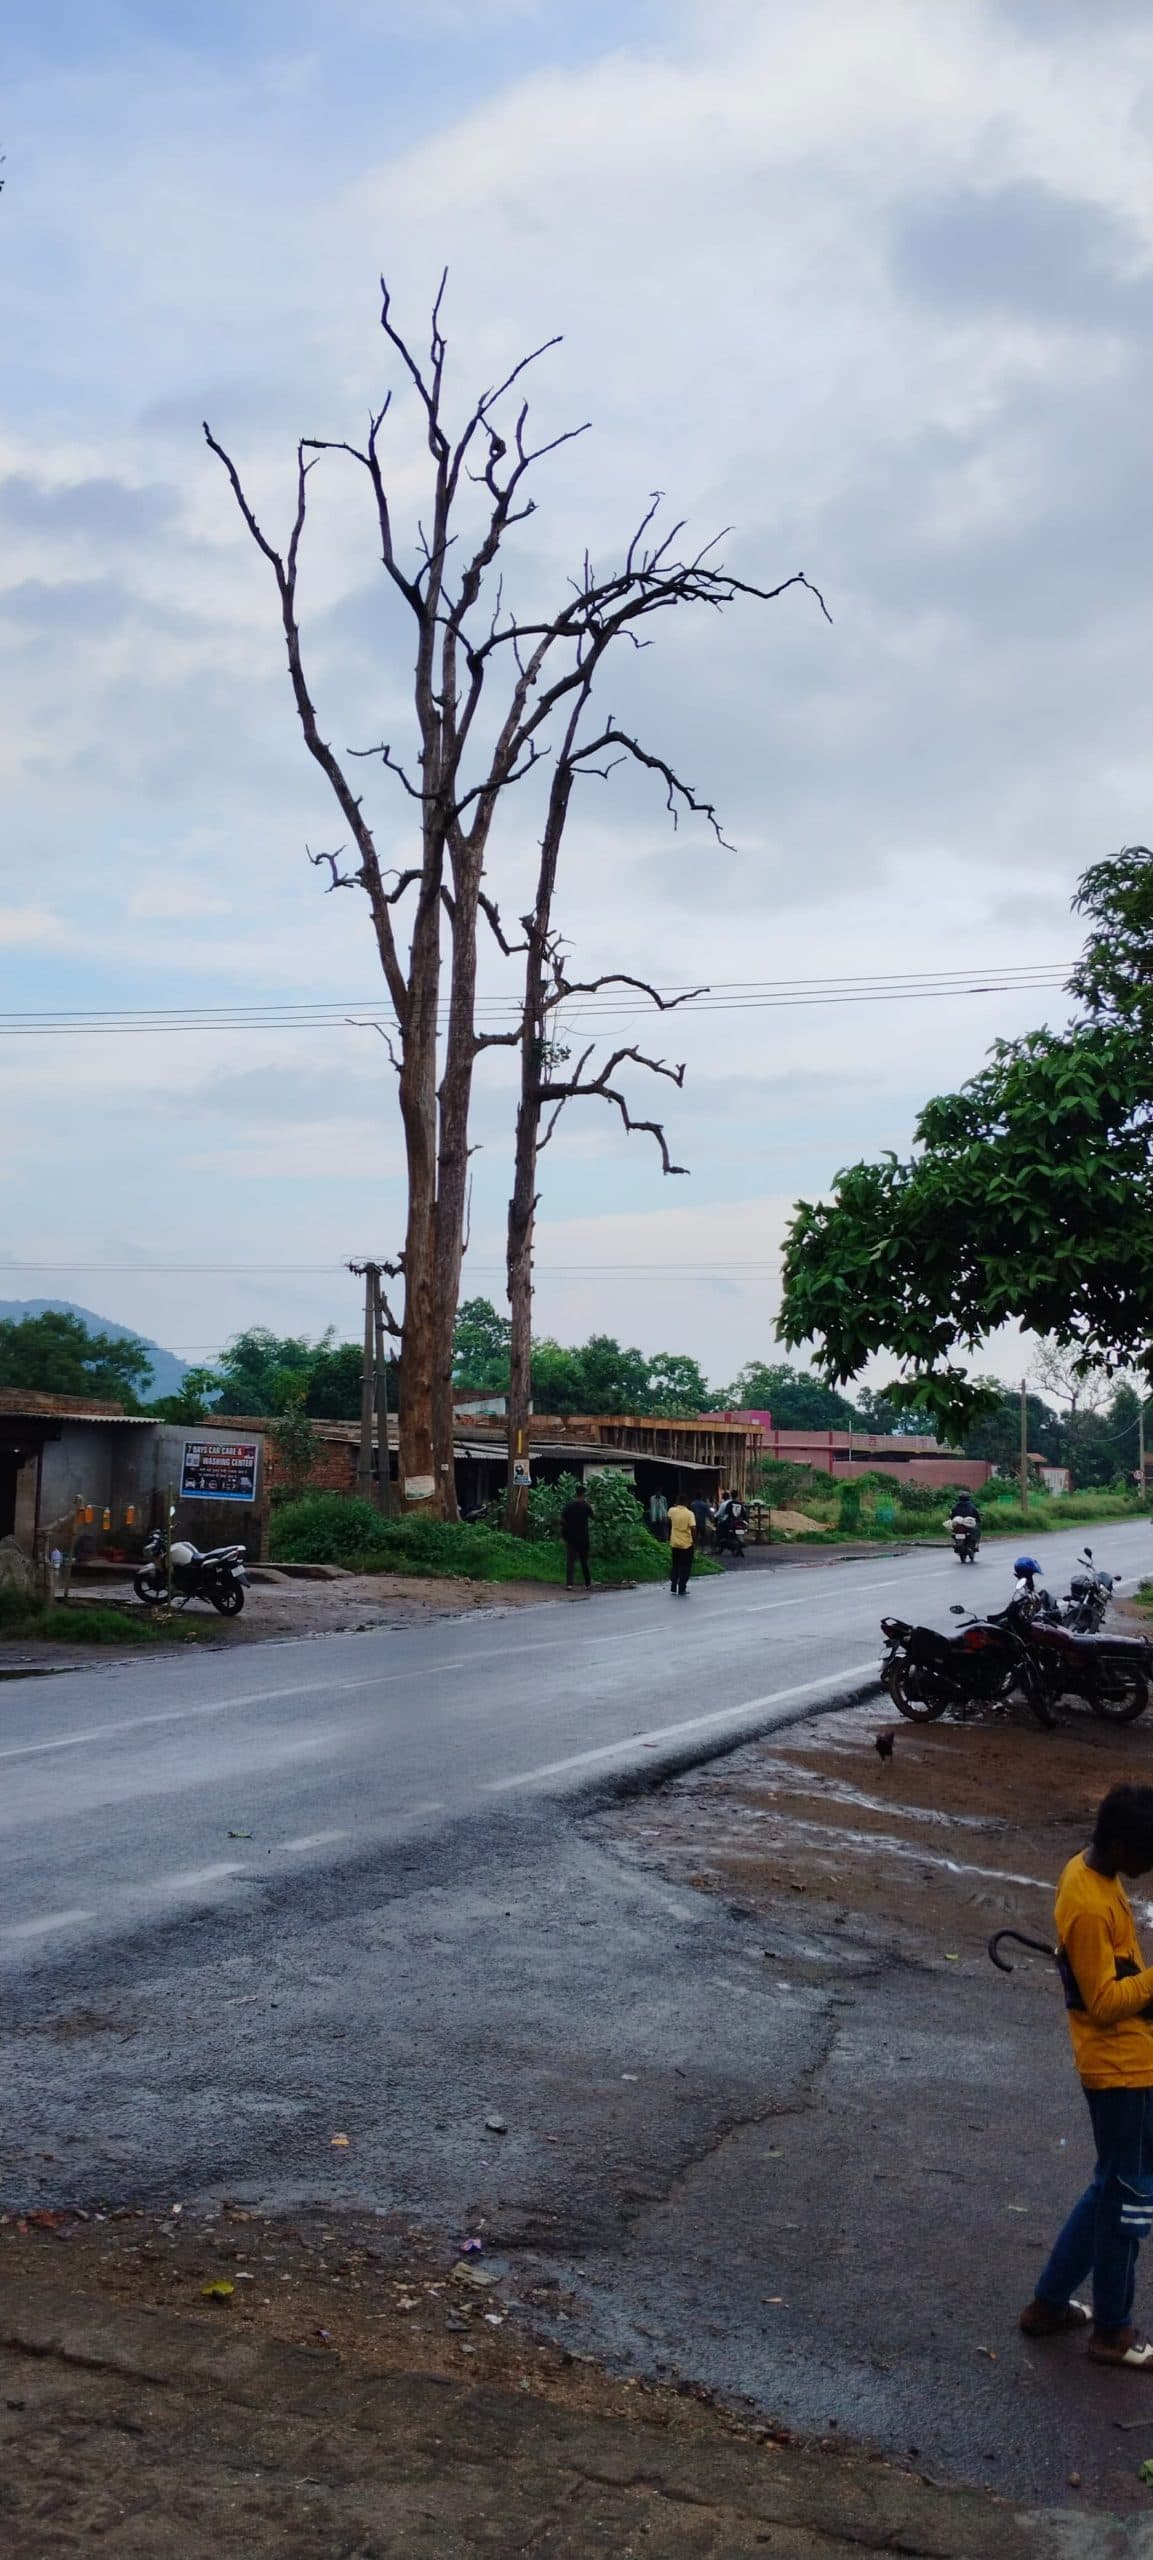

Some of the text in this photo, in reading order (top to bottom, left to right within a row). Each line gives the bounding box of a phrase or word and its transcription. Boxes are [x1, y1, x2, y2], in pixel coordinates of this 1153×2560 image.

[208, 1446, 220, 1454] CAR
[222, 1447, 236, 1455] CARE
[202, 1457, 253, 1467] WASHING CENTER
